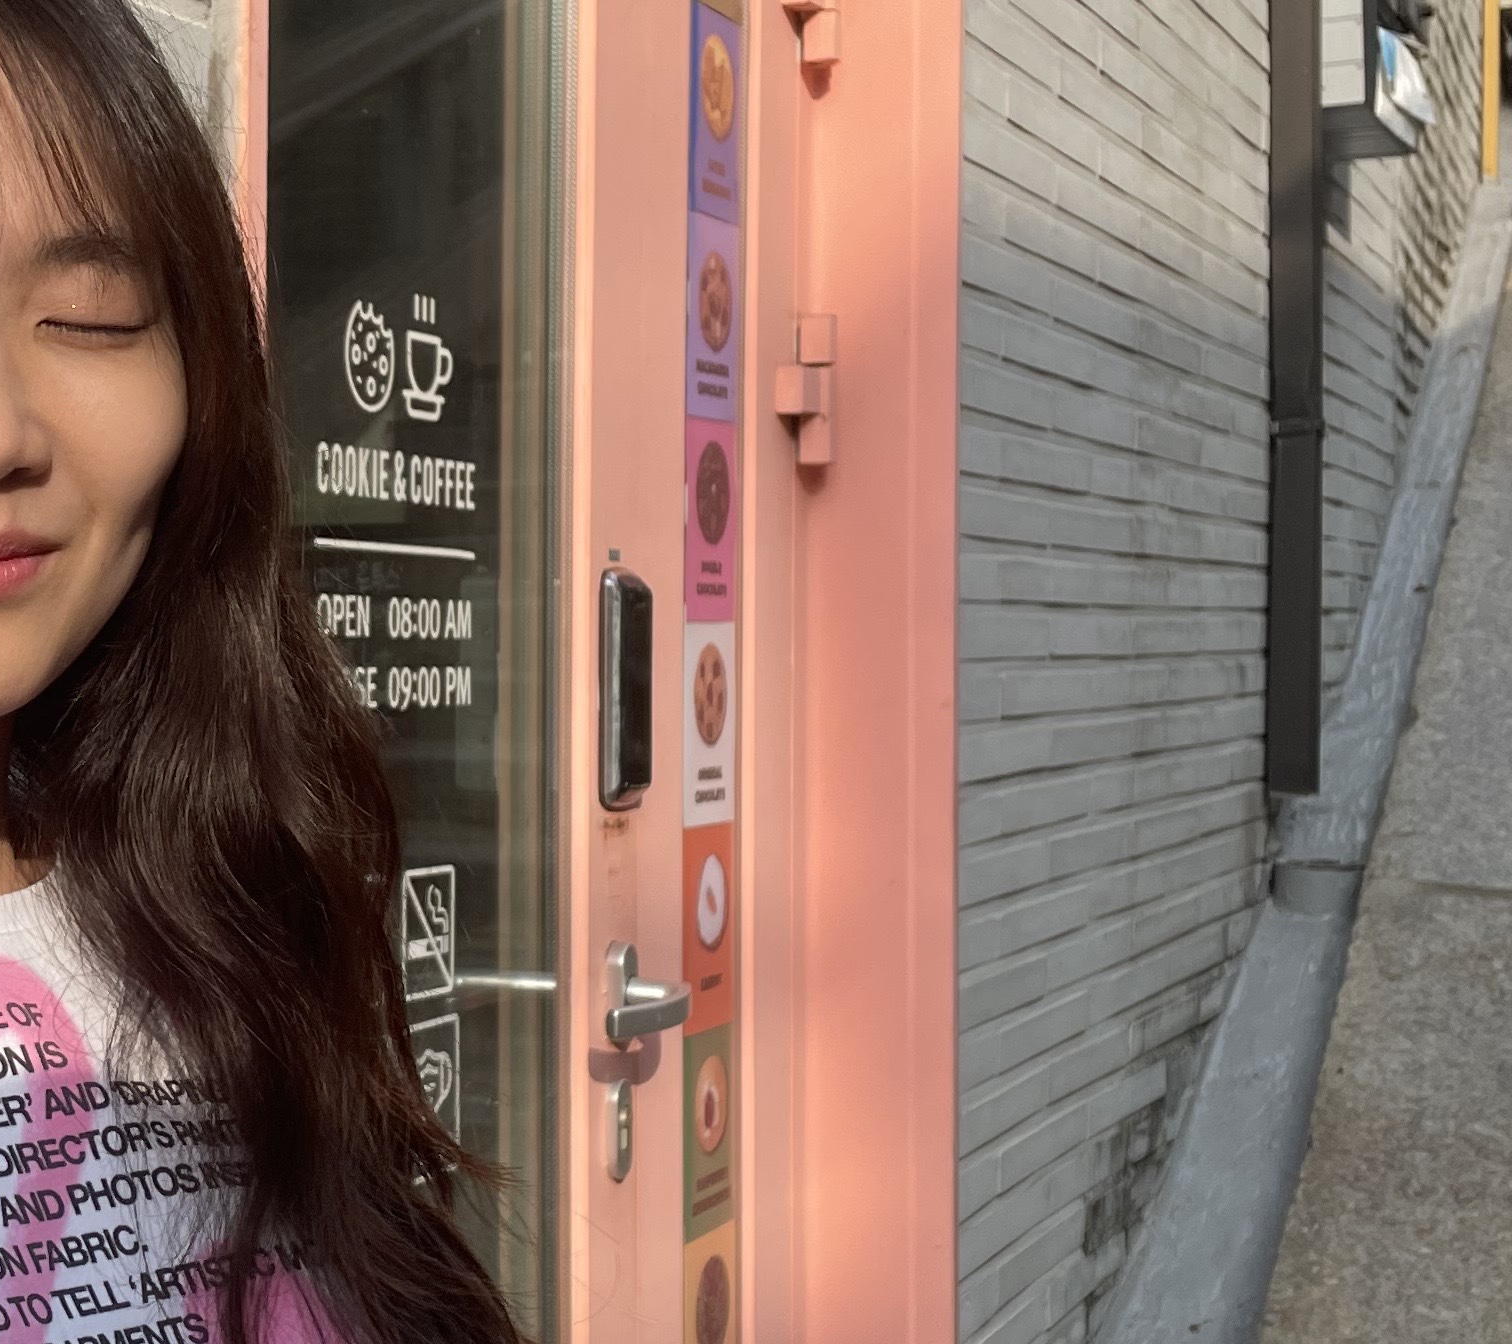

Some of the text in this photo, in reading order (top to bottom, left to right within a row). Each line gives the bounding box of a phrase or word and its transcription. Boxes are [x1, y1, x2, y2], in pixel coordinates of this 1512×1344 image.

[317, 440, 476, 511] COOKIE & COFFEE
[316, 592, 472, 639] OPEN 08:00 AM
[388, 665, 441, 712] 09:00
[445, 665, 472, 706] PM
[7, 1002, 43, 1027] OF
[36, 1041, 69, 1071] IS
[44, 1081, 110, 1120] AND
[0, 1189, 66, 1226] AND
[65, 1163, 200, 1215] PHOTOS
[7, 1293, 54, 1328] TO
[50, 1280, 131, 1320] TELL
